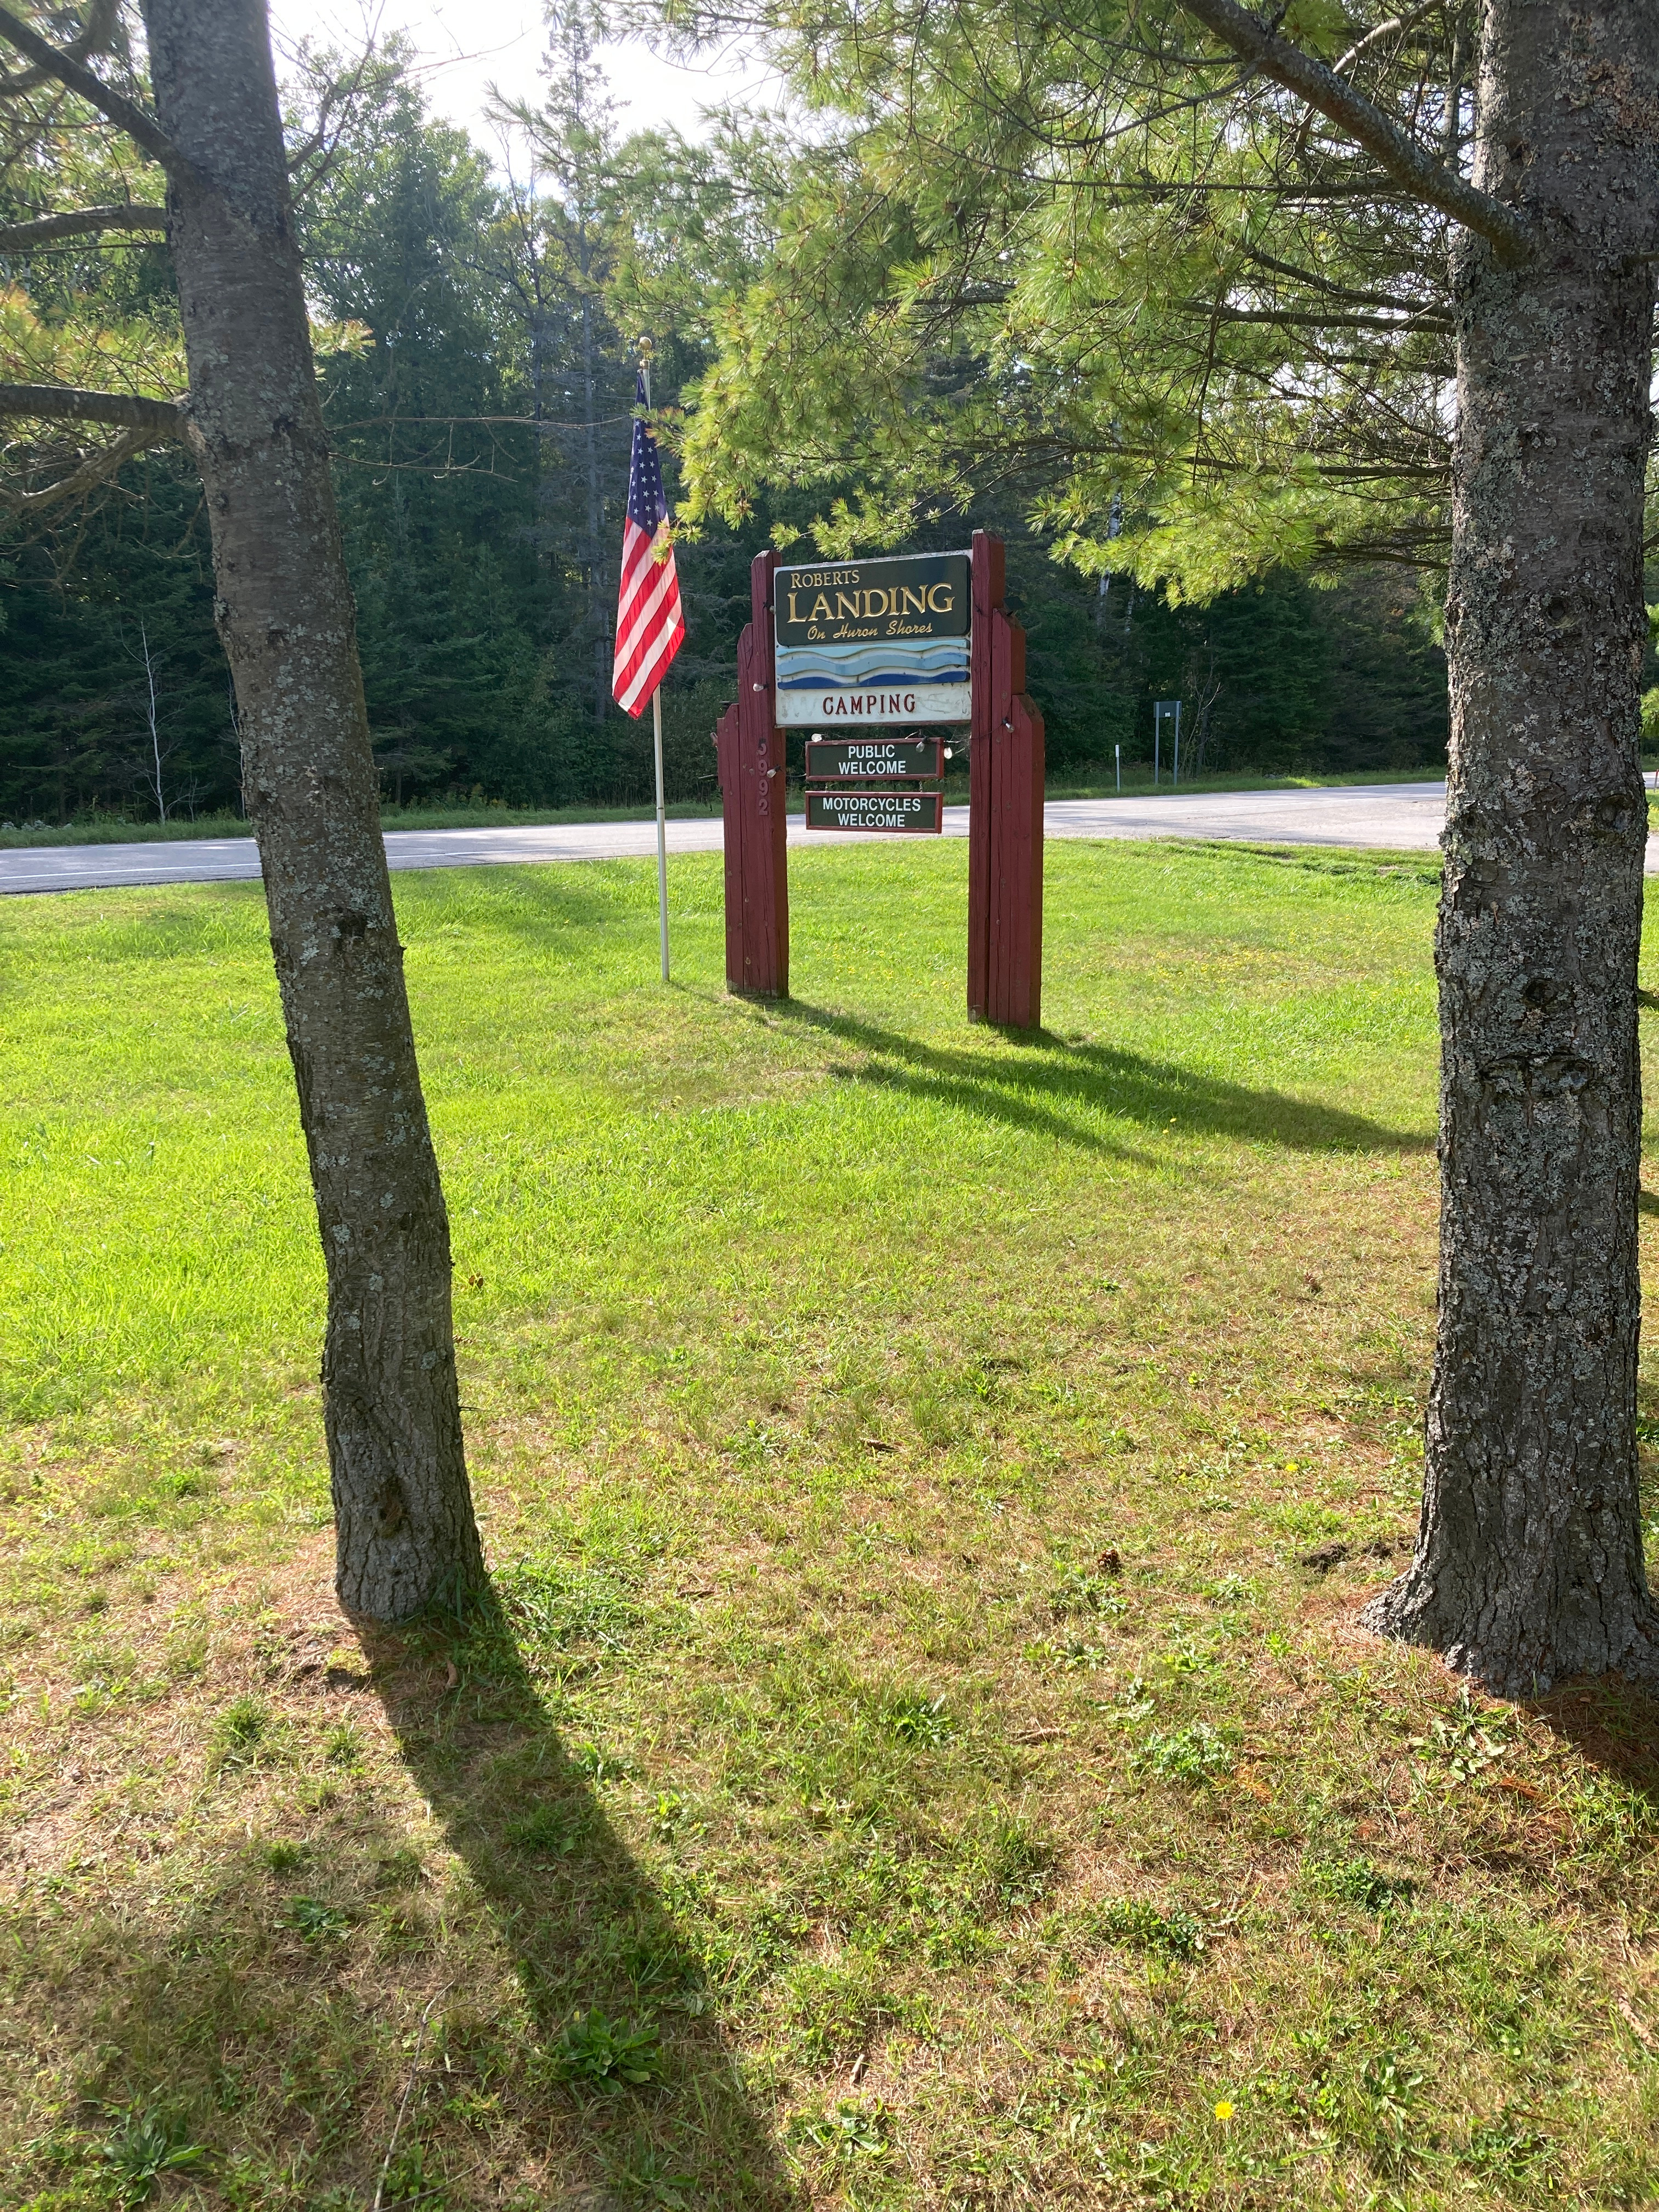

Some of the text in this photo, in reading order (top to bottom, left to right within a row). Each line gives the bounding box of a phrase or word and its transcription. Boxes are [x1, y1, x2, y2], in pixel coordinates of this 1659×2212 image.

[791, 569, 860, 589] ROBERTS
[787, 583, 956, 623] LANDING
[807, 618, 933, 640] On Huron Shores
[822, 693, 916, 715] CAMPING
[848, 744, 895, 759] PUBLIC
[838, 760, 906, 775] WELCOME
[823, 797, 921, 811] MOTORCYCLES
[838, 814, 905, 827] WELCOME
